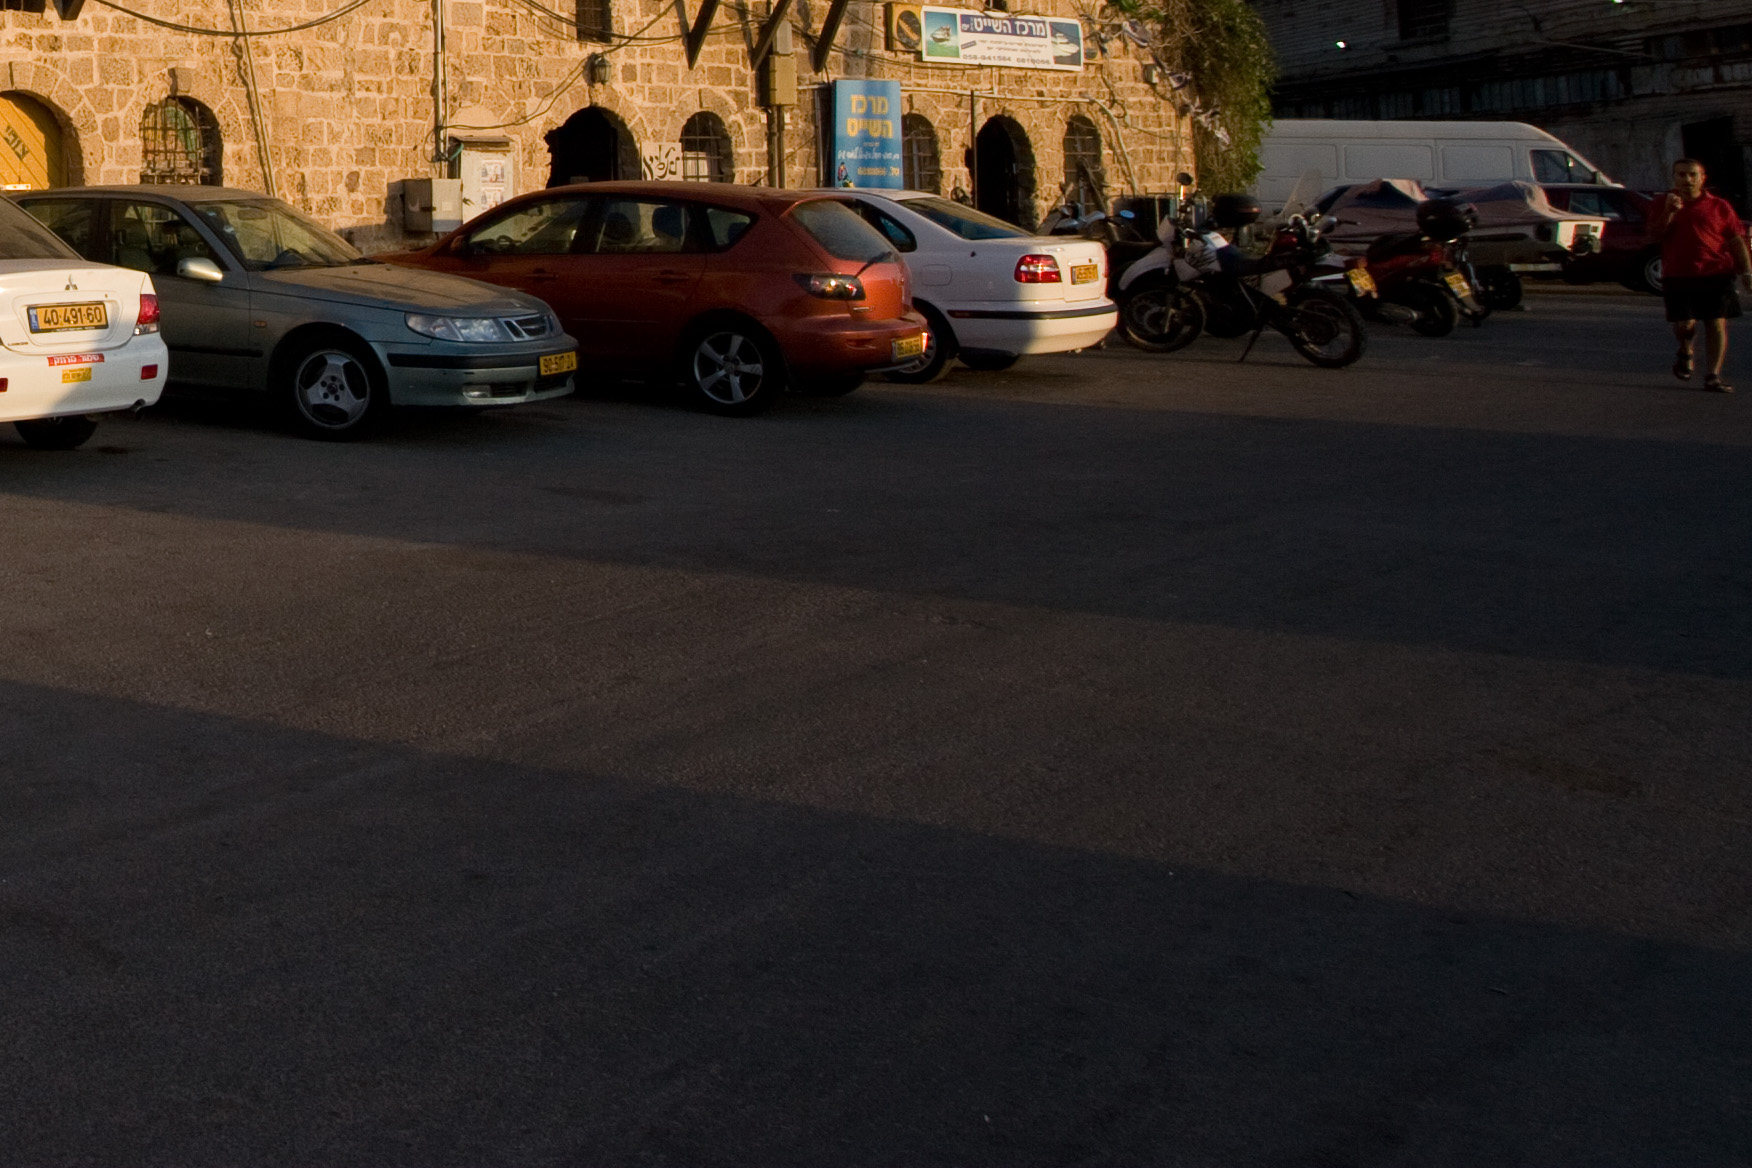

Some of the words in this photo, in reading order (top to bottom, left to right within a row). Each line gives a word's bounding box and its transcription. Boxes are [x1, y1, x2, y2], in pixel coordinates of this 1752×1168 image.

[973, 17, 1012, 34] השייט
[1014, 20, 1046, 37] מרכז
[850, 94, 890, 115] מרכז
[4, 125, 30, 161] צופי
